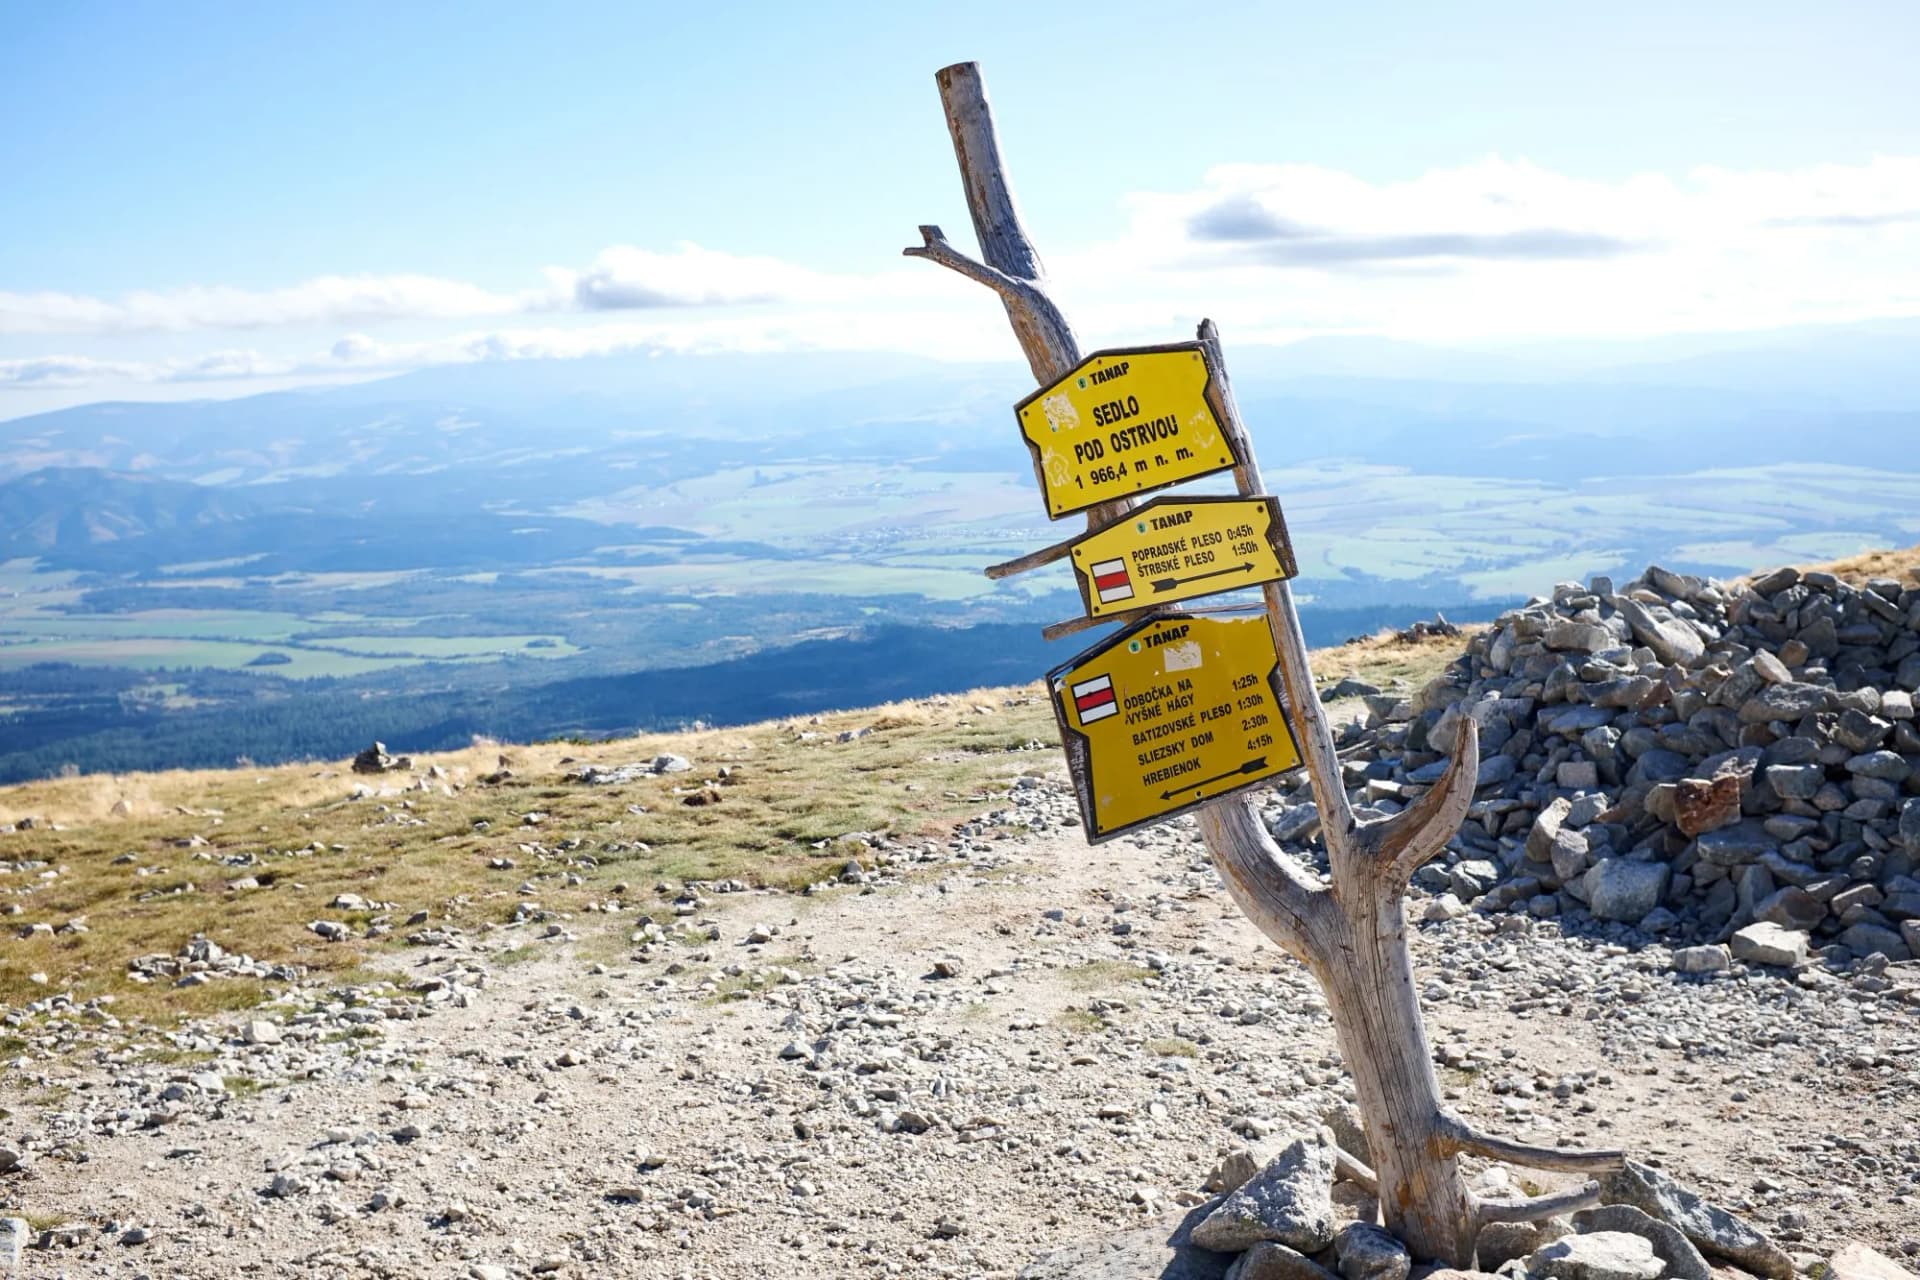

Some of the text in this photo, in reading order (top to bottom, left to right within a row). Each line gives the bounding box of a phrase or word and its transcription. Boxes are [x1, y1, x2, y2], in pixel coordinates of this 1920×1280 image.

[1090, 362, 1129, 385] TANAP
[1093, 395, 1139, 426] SEDLO
[1074, 415, 1178, 464] POD OSTRVOU
[1076, 447, 1193, 489] 1 966,4 m n. m.
[1151, 510, 1193, 530] TANAP
[1132, 525, 1253, 562] POPRADSKÉ PLESO 0:45h
[1137, 541, 1258, 577] ŠTRBSKÉ PLESO 1:50h
[1143, 625, 1189, 648] TANAP
[1124, 678, 1193, 711] ODBOČKA NA
[1167, 693, 1194, 712] HÁGY
[1232, 675, 1258, 691] 1:25h
[1132, 695, 1263, 745] BATIZOVSKÉ PLESO 1:30h
[1138, 714, 1268, 765] SLIEZSKY DOM 2:30h
[1143, 734, 1272, 786] HREBIENOK 4:15h
